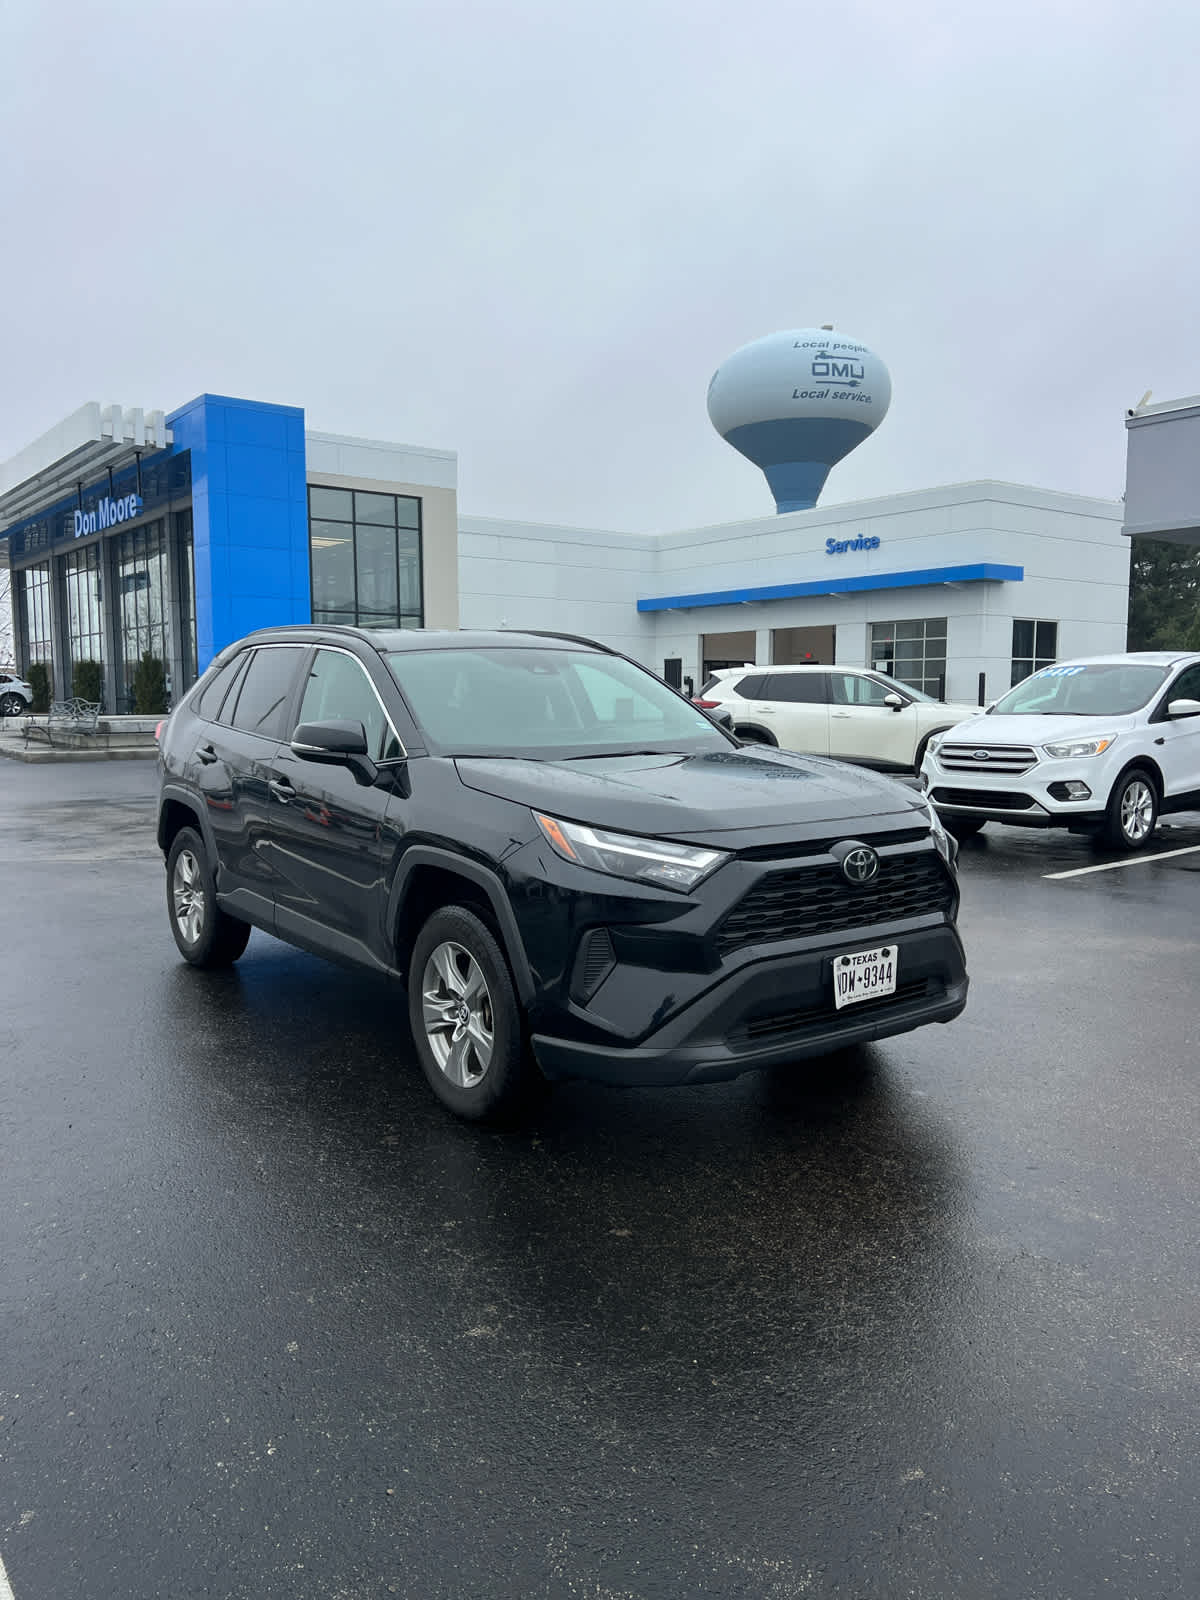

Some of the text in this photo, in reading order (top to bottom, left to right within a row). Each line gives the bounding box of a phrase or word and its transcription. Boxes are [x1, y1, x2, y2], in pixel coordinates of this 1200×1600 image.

[793, 341, 830, 349] Local
[812, 362, 865, 379] OMU
[792, 388, 831, 400] Local
[74, 493, 137, 538] Don Moore
[825, 533, 881, 555] Service
[852, 952, 878, 966] TEXAS
